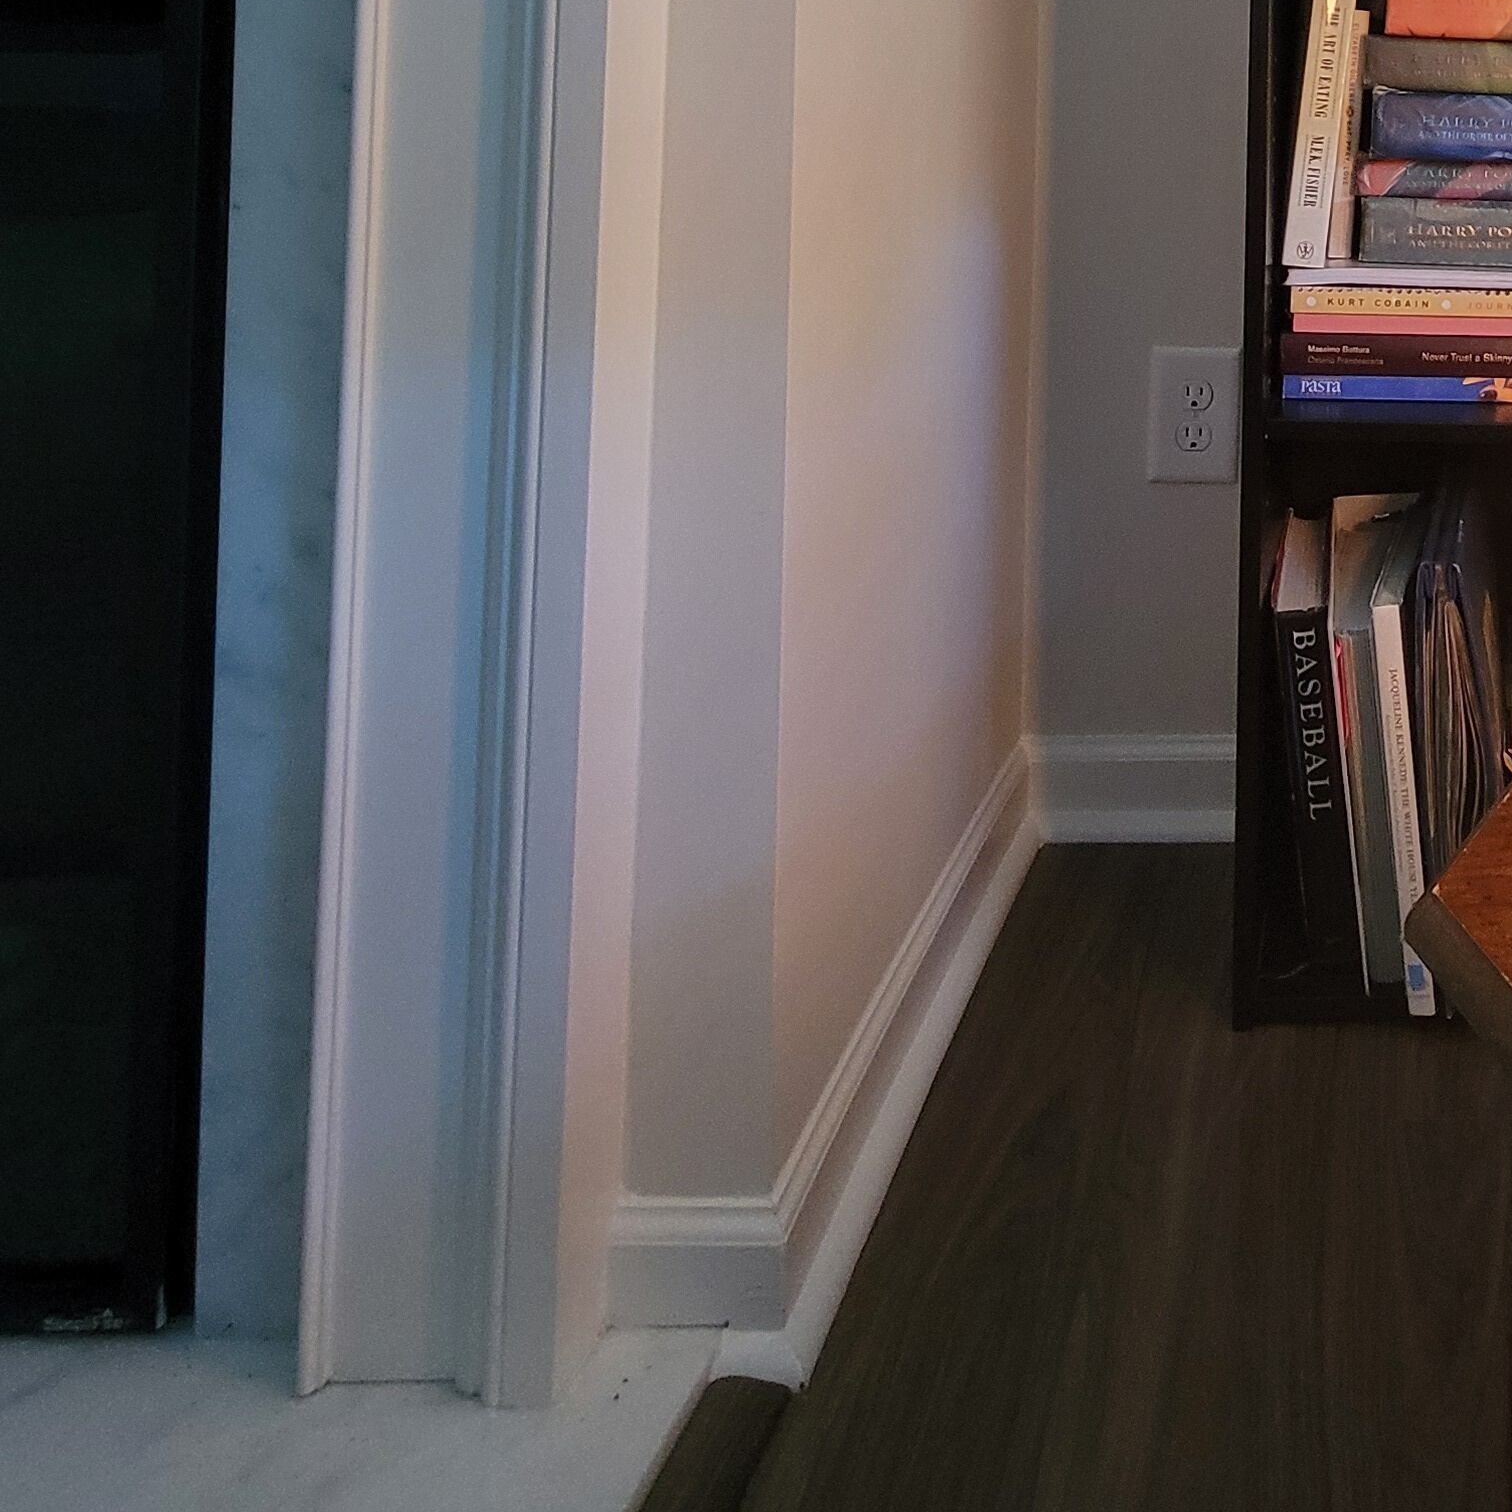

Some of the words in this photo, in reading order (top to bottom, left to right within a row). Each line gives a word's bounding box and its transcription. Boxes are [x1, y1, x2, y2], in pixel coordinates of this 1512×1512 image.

[1323, 32, 1336, 54] ART
[1320, 58, 1333, 73] OF
[1314, 75, 1332, 118] EATING
[1420, 114, 1494, 129] HARRY
[1303, 168, 1320, 208] FISHER
[1408, 224, 1480, 238] HARRY
[1327, 297, 1365, 307] KURT
[1374, 298, 1431, 309] COBAIN
[1307, 344, 1341, 353] Massimo
[1421, 351, 1448, 362] Never
[1450, 352, 1473, 363] Trust
[1483, 352, 1512, 366] Skinny
[1388, 667, 1404, 731] JACQUELINE
[1292, 627, 1332, 821] BASEBALL
[1399, 787, 1411, 808] THE
[1401, 810, 1414, 846] WHITE
[1404, 849, 1417, 883] HOUSE
